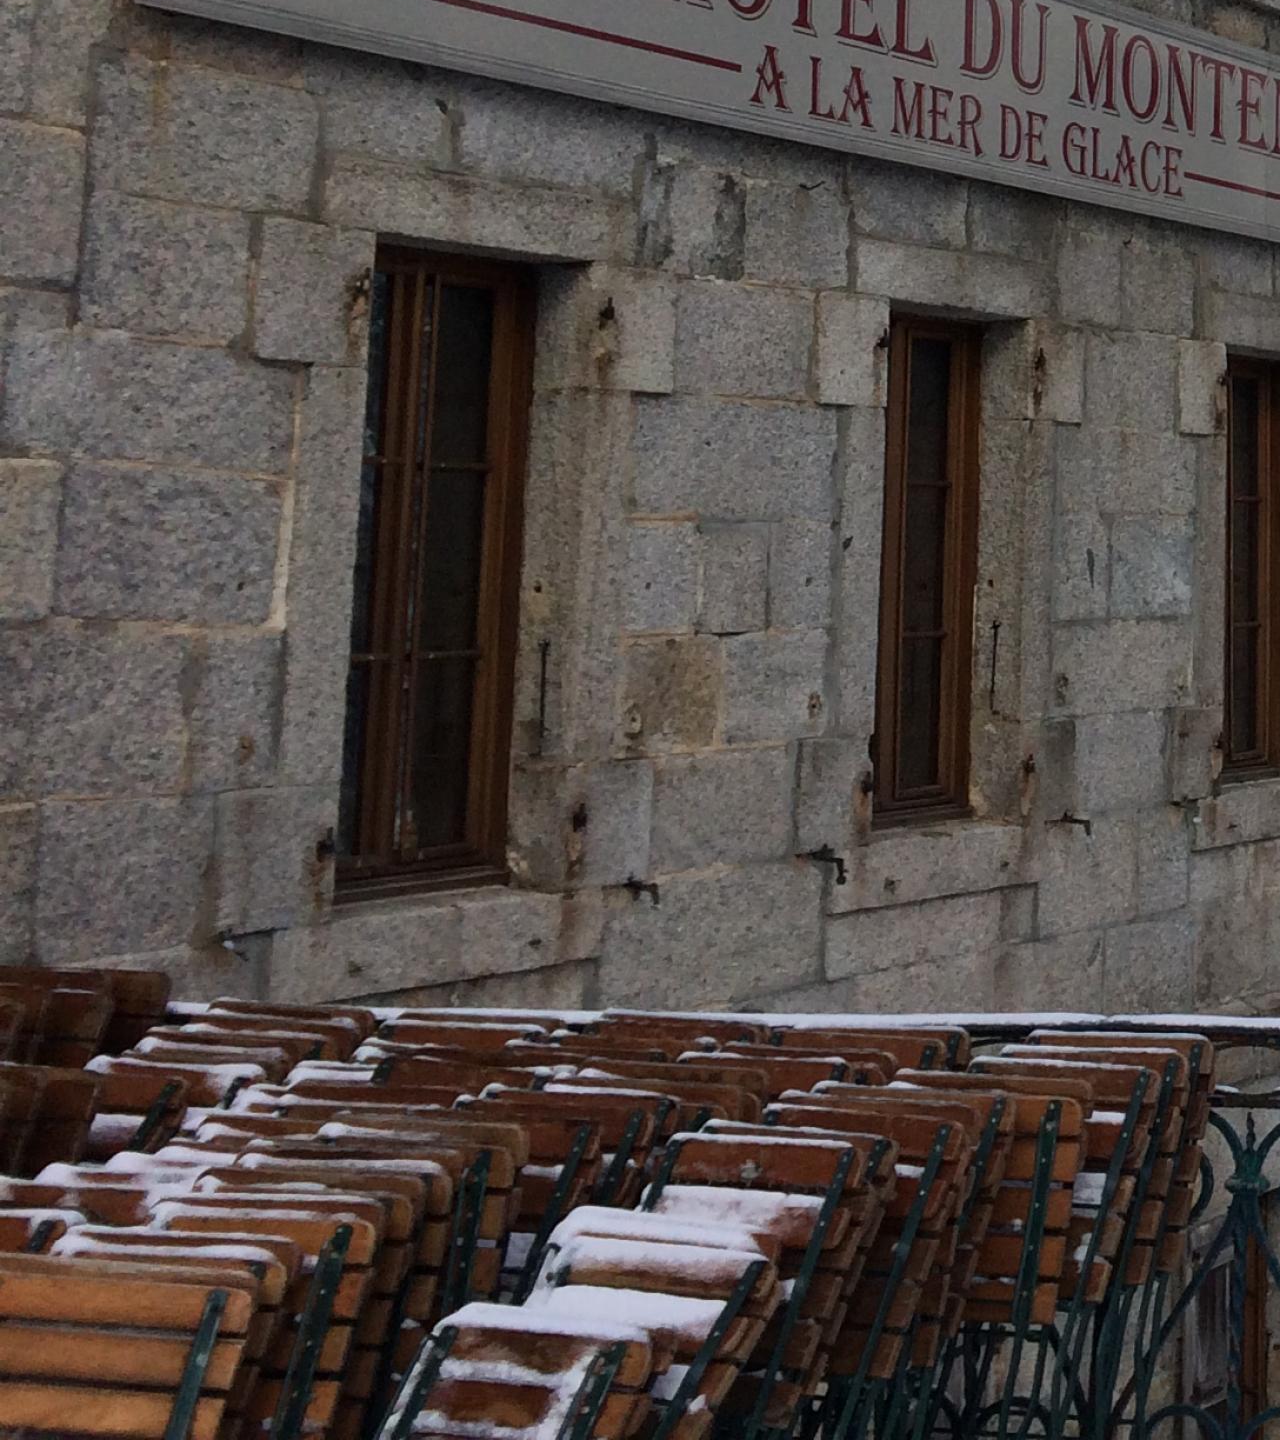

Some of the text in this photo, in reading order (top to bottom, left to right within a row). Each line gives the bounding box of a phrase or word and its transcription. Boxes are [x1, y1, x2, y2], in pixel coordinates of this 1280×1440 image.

[749, 44, 1184, 198] A LA MER DE GLACE
